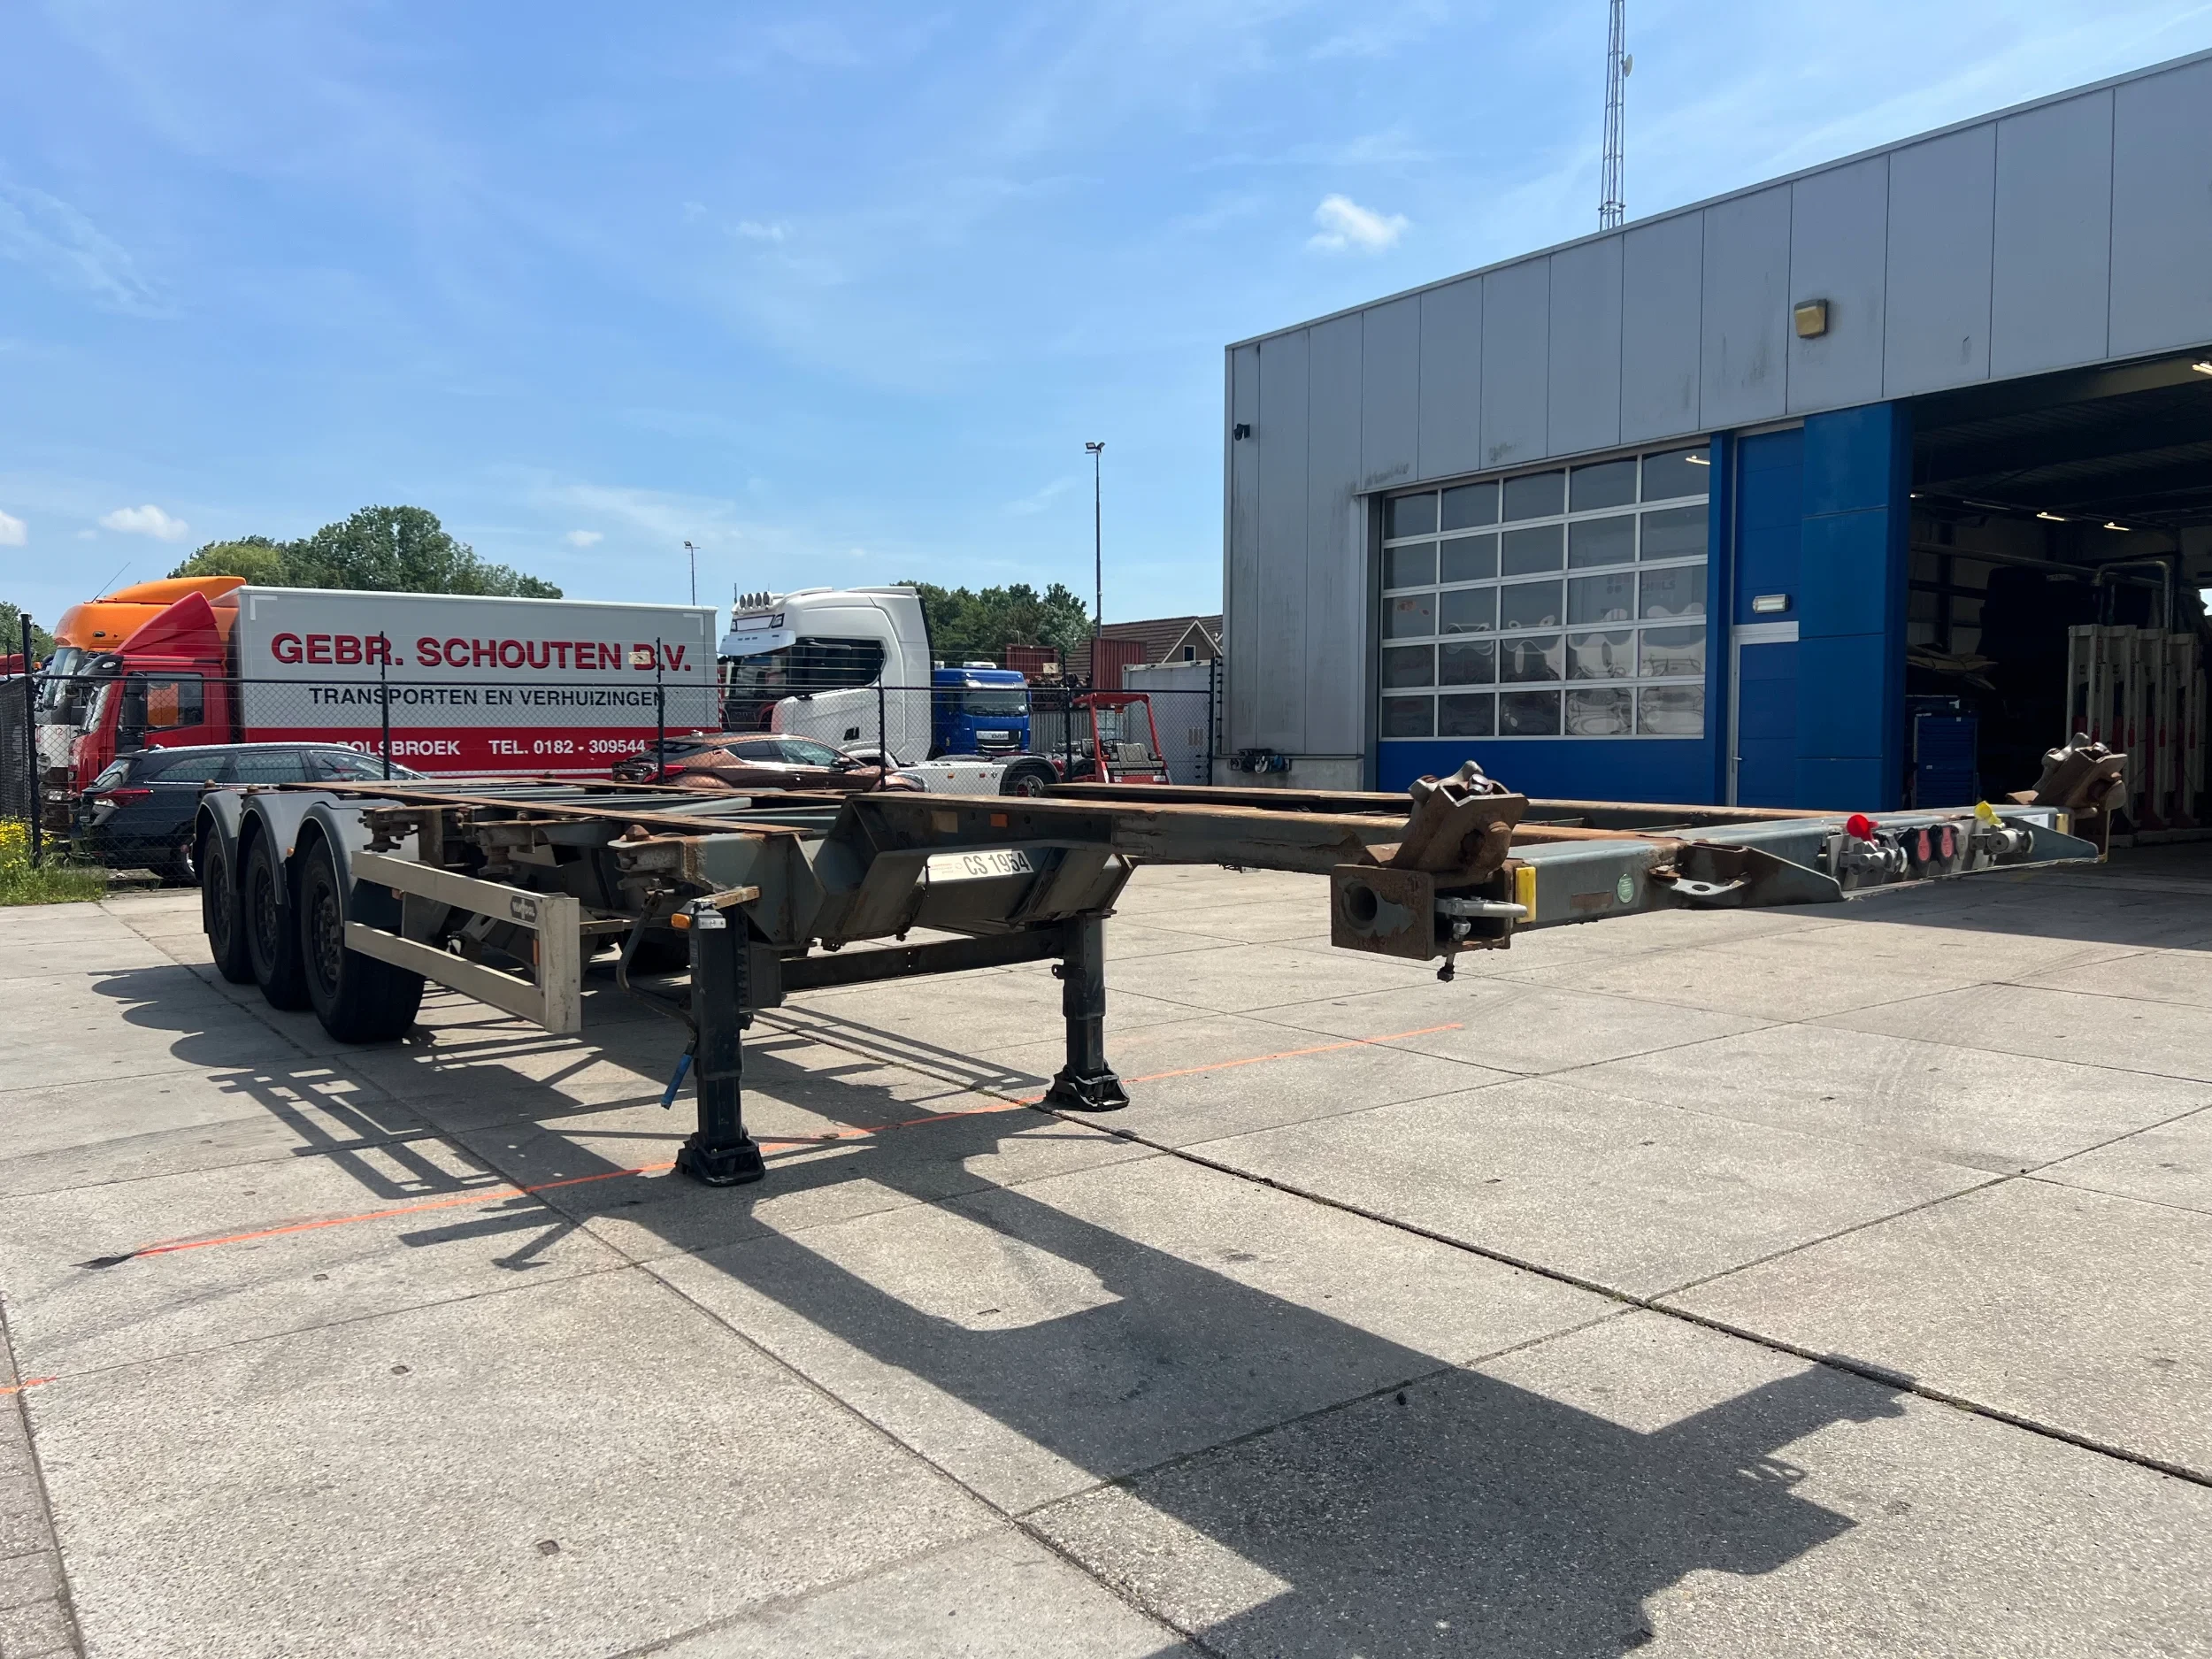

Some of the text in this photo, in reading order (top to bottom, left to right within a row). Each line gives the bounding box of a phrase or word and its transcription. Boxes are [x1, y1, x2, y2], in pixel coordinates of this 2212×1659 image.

[272, 633, 403, 665] GEBR.
[416, 637, 622, 671] SCHOUTEN
[309, 687, 477, 705] TRANSPORTEN
[486, 690, 512, 705] EN
[336, 741, 461, 756] OLSBROEK
[488, 740, 528, 755] TEL.
[534, 740, 573, 754] 0182
[588, 739, 646, 753] 309544
[963, 855, 988, 875] CS
[988, 852, 1031, 873] 1954
